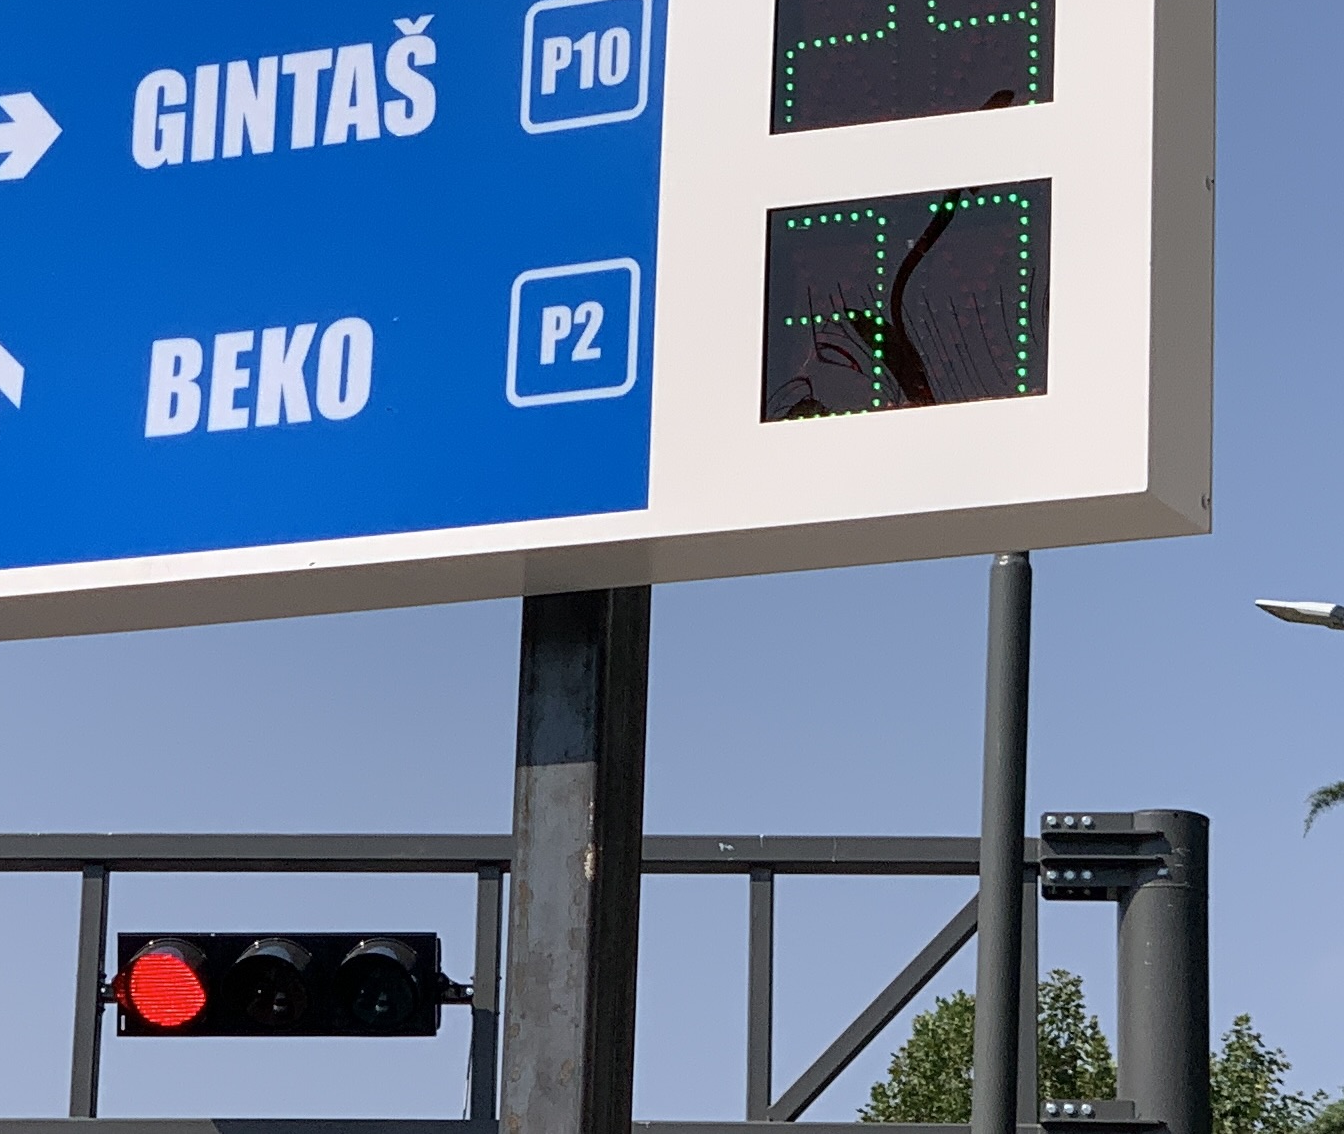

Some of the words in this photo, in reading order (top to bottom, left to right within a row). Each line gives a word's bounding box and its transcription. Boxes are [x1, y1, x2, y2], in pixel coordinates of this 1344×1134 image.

[131, 13, 437, 169] GINTAŠ
[540, 26, 631, 95] P10
[144, 316, 374, 439] BEKO
[539, 300, 605, 366] P2
